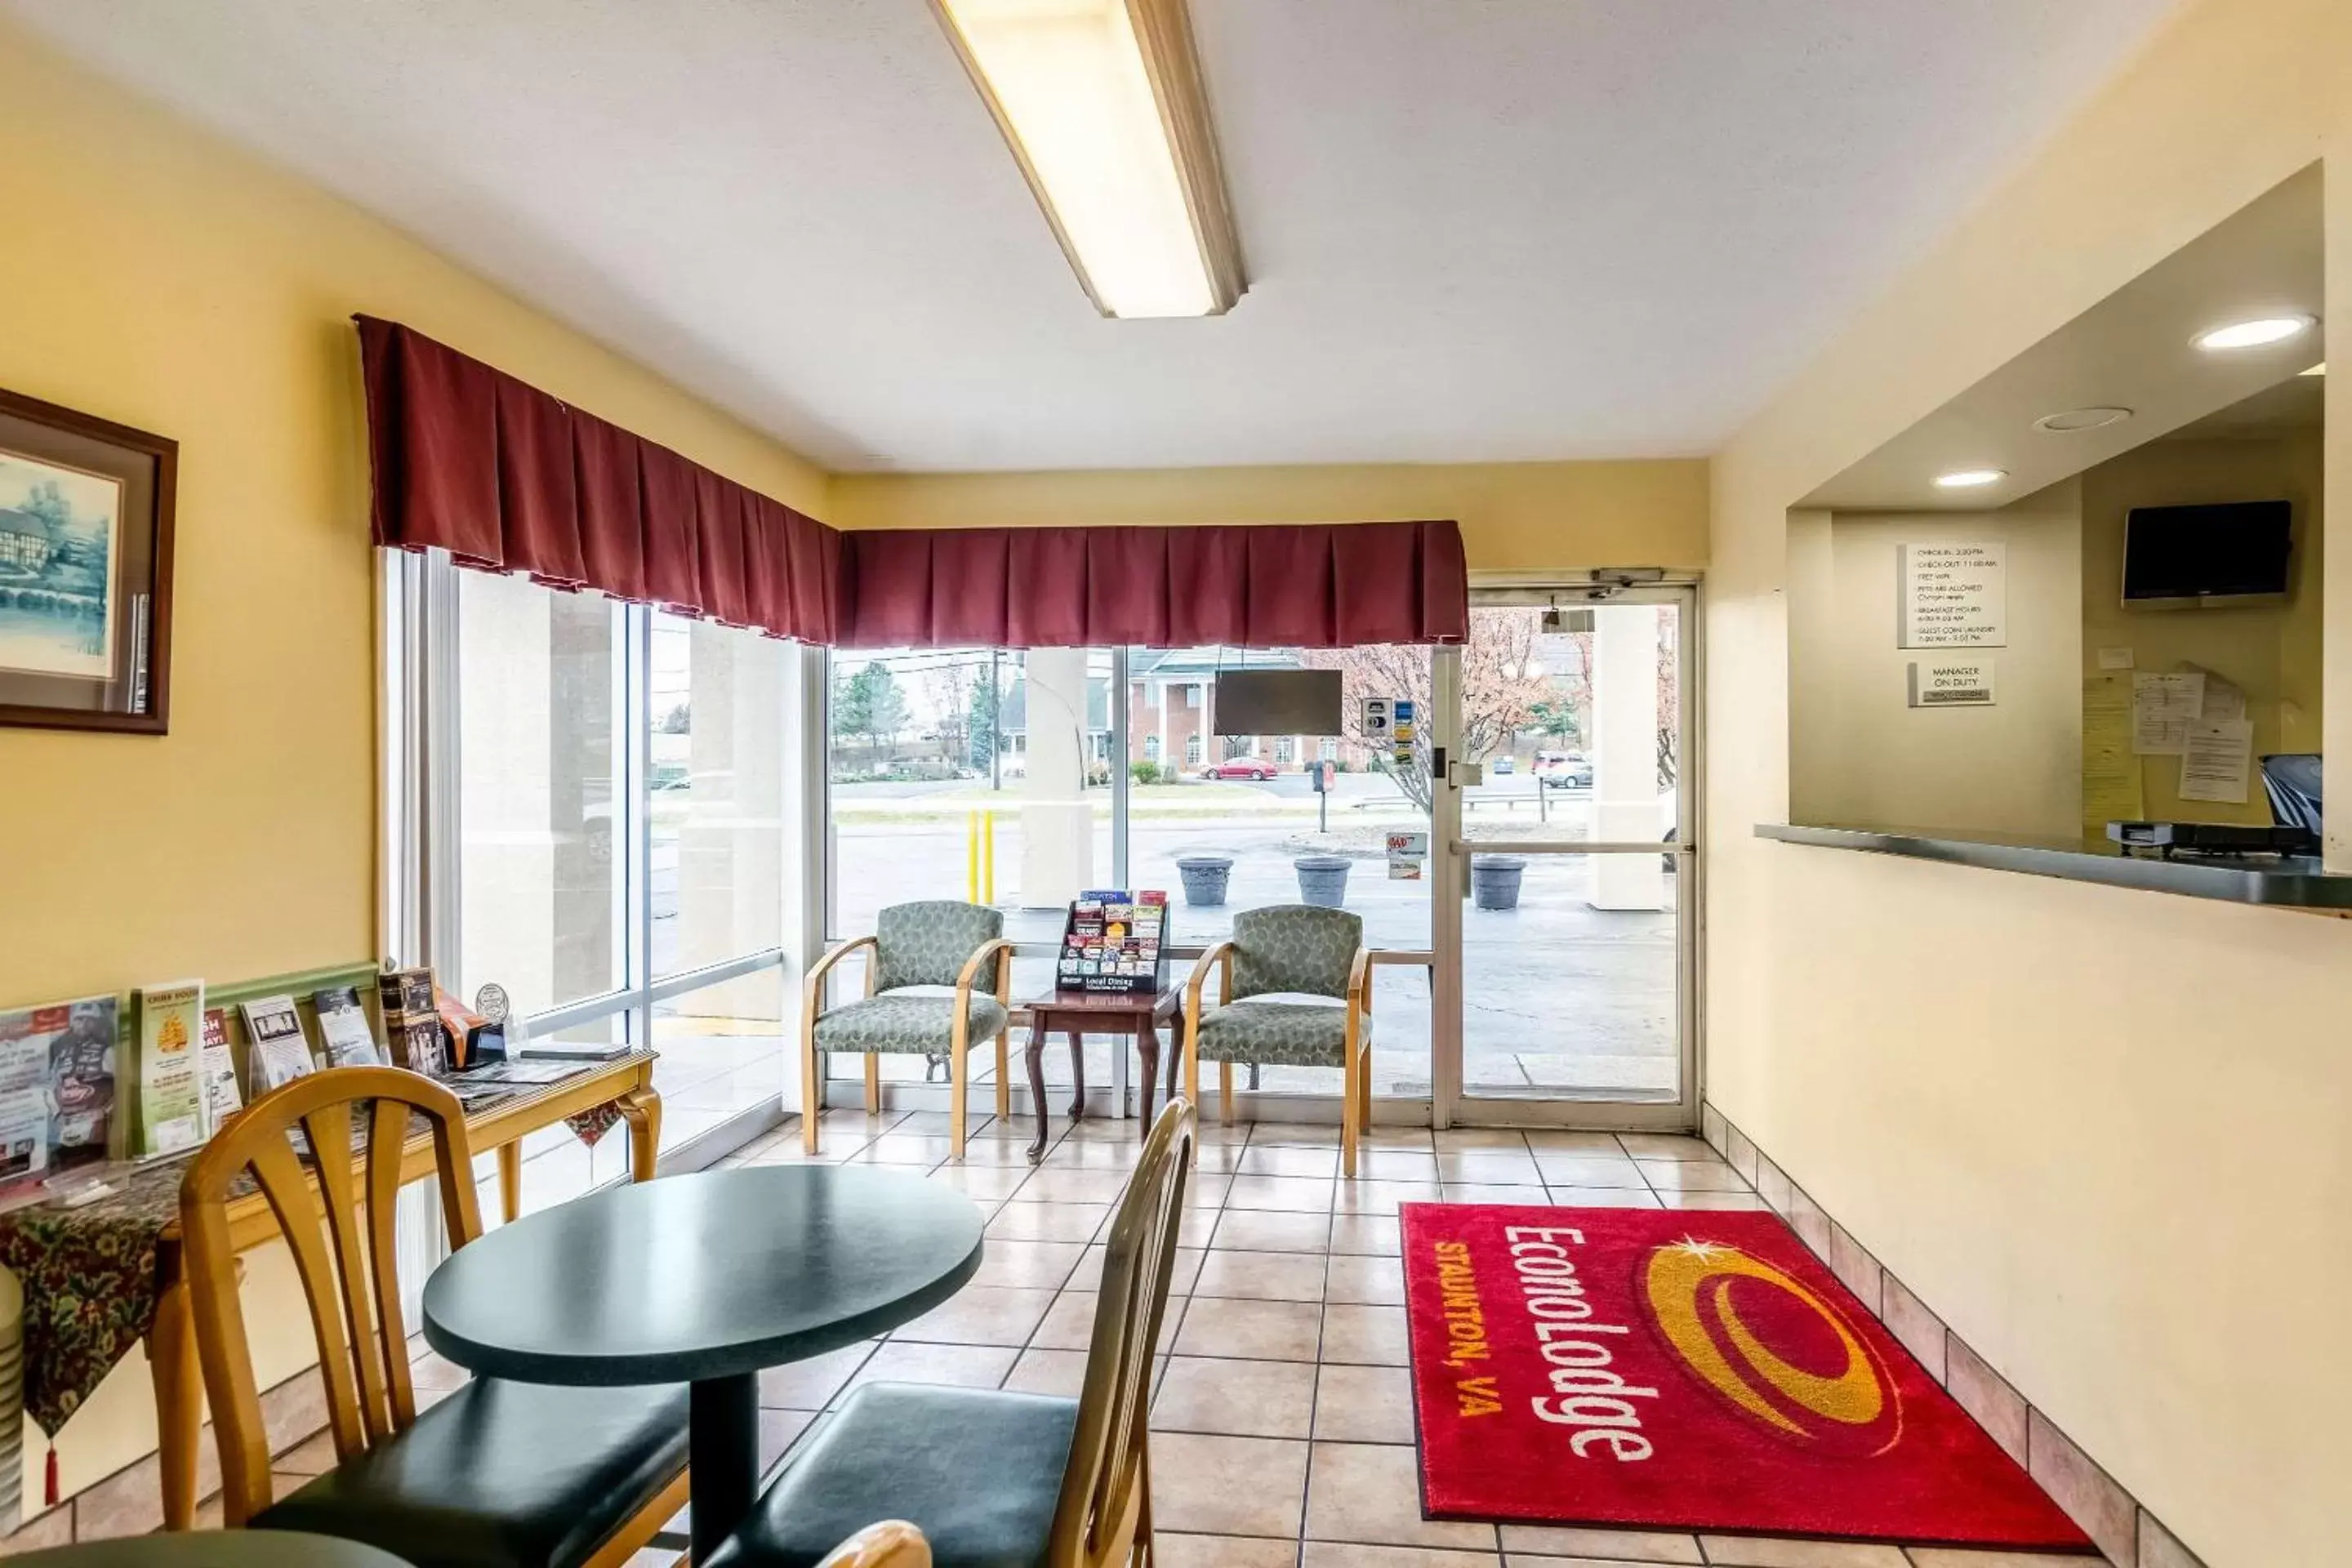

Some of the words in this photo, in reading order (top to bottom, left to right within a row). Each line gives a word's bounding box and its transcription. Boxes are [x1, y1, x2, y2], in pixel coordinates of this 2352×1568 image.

[1949, 584, 1983, 592] ALLOWED
[1932, 667, 1980, 676] MANAGER
[1934, 679, 1950, 687] ON
[1953, 678, 1978, 686] DUTY
[1085, 976, 1106, 986] Local
[1107, 977, 1134, 987] Dining
[1434, 1241, 1494, 1368] STAUNTON,
[1459, 1376, 1502, 1418] VA
